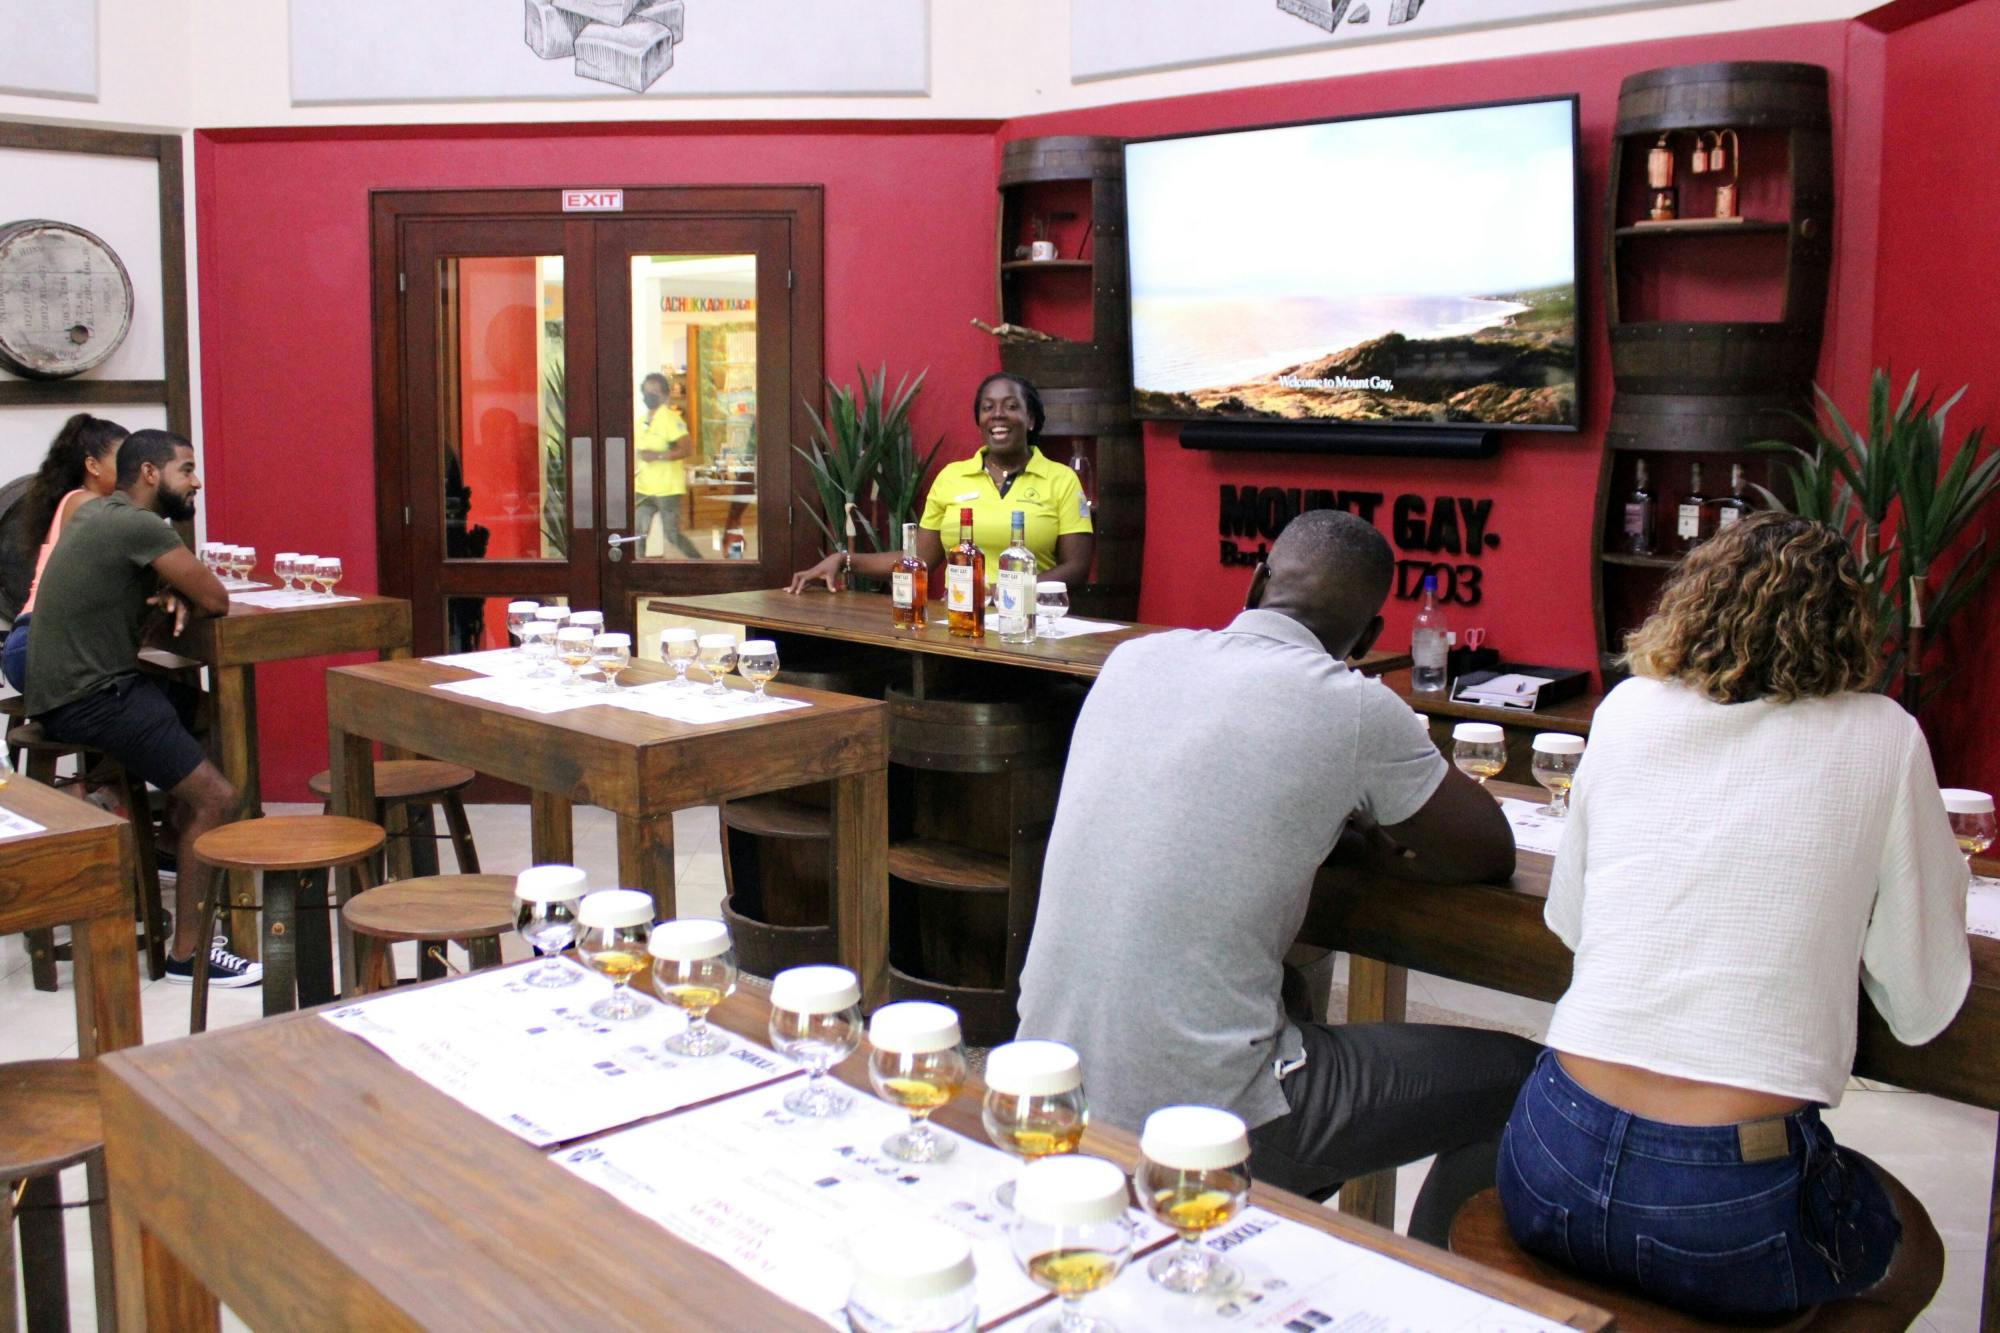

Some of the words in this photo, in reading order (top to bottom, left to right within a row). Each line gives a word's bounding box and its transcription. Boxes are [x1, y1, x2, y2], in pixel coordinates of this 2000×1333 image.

[567, 193, 618, 207] EXIT
[1279, 375, 1322, 389] Welcome
[1323, 377, 1335, 388] to
[1336, 375, 1369, 389] Mount
[1395, 560, 1483, 607] 1703
